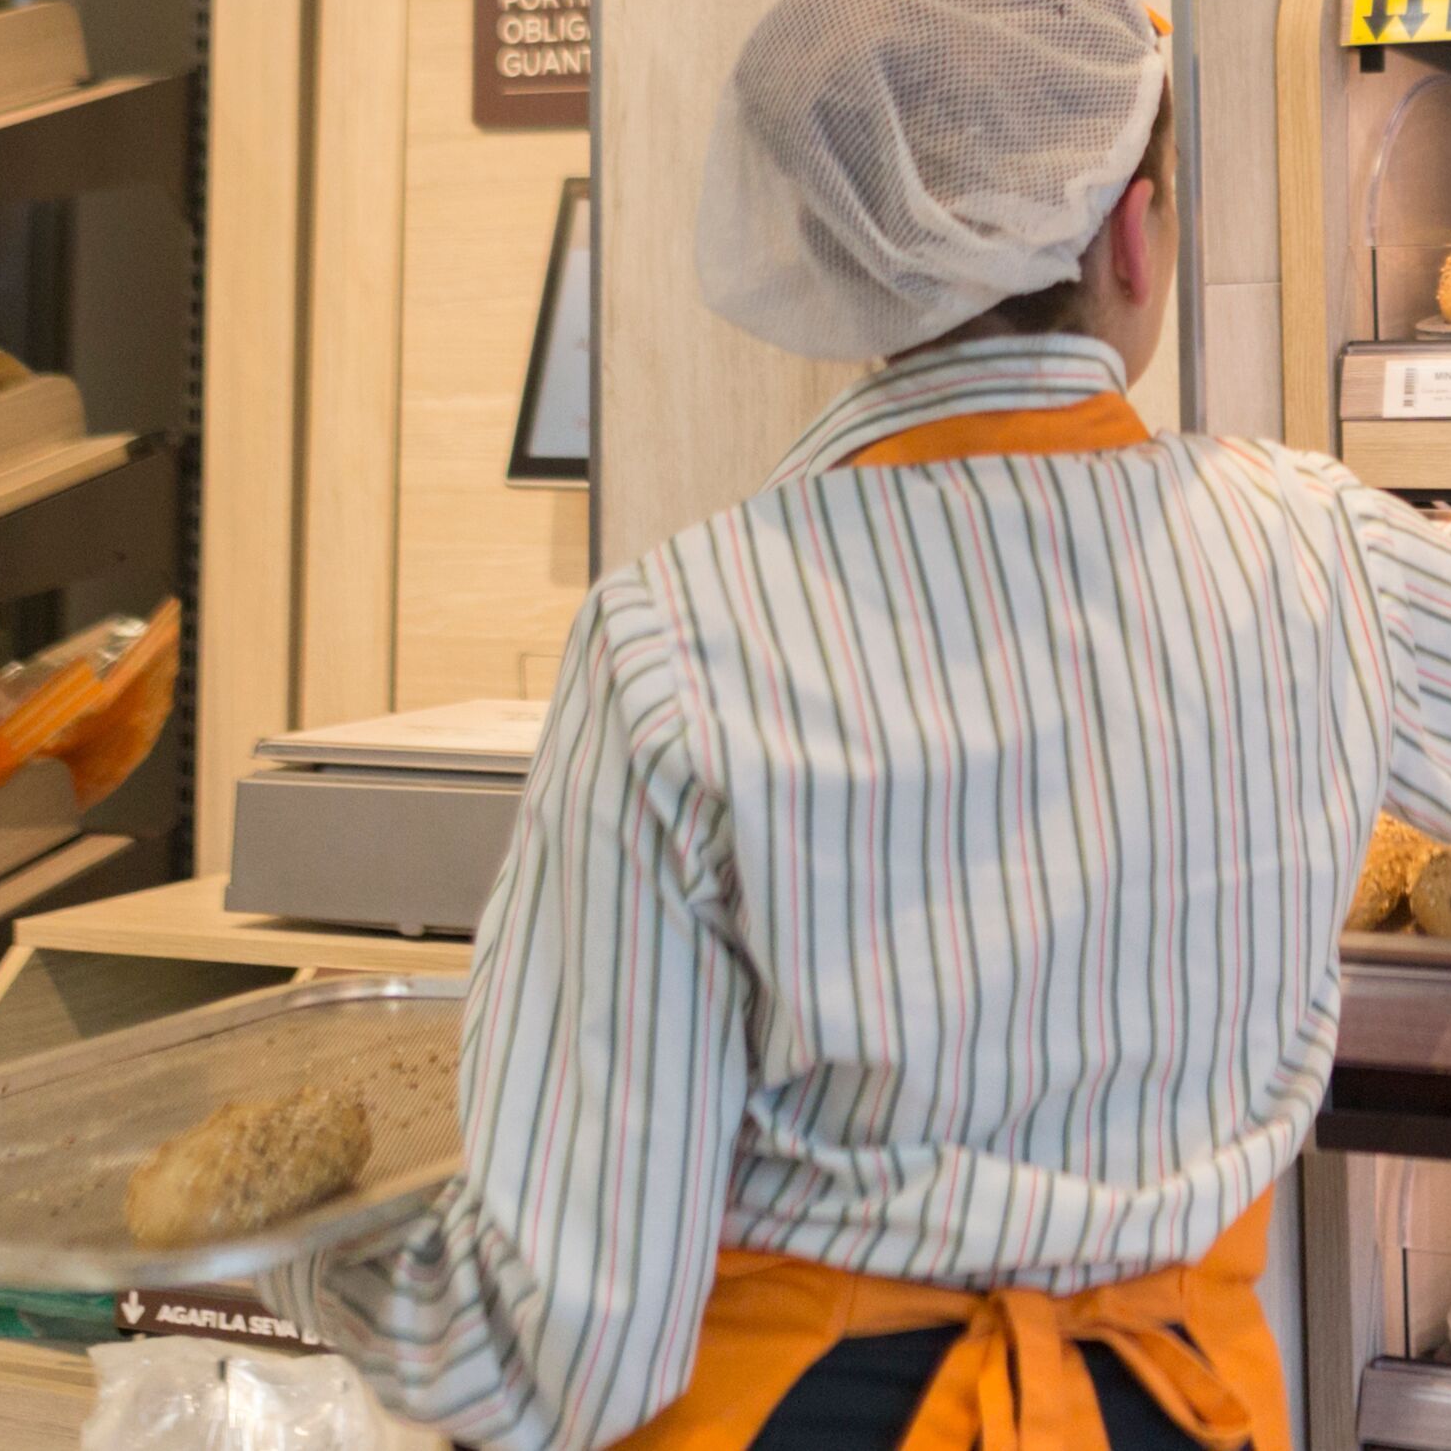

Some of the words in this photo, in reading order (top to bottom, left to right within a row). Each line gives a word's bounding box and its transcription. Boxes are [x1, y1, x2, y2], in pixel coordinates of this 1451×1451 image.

[496, 11, 591, 44] OBLIG
[156, 1304, 216, 1328] AGAFI
[217, 1312, 248, 1332] LA
[249, 1315, 299, 1339] SEVA
